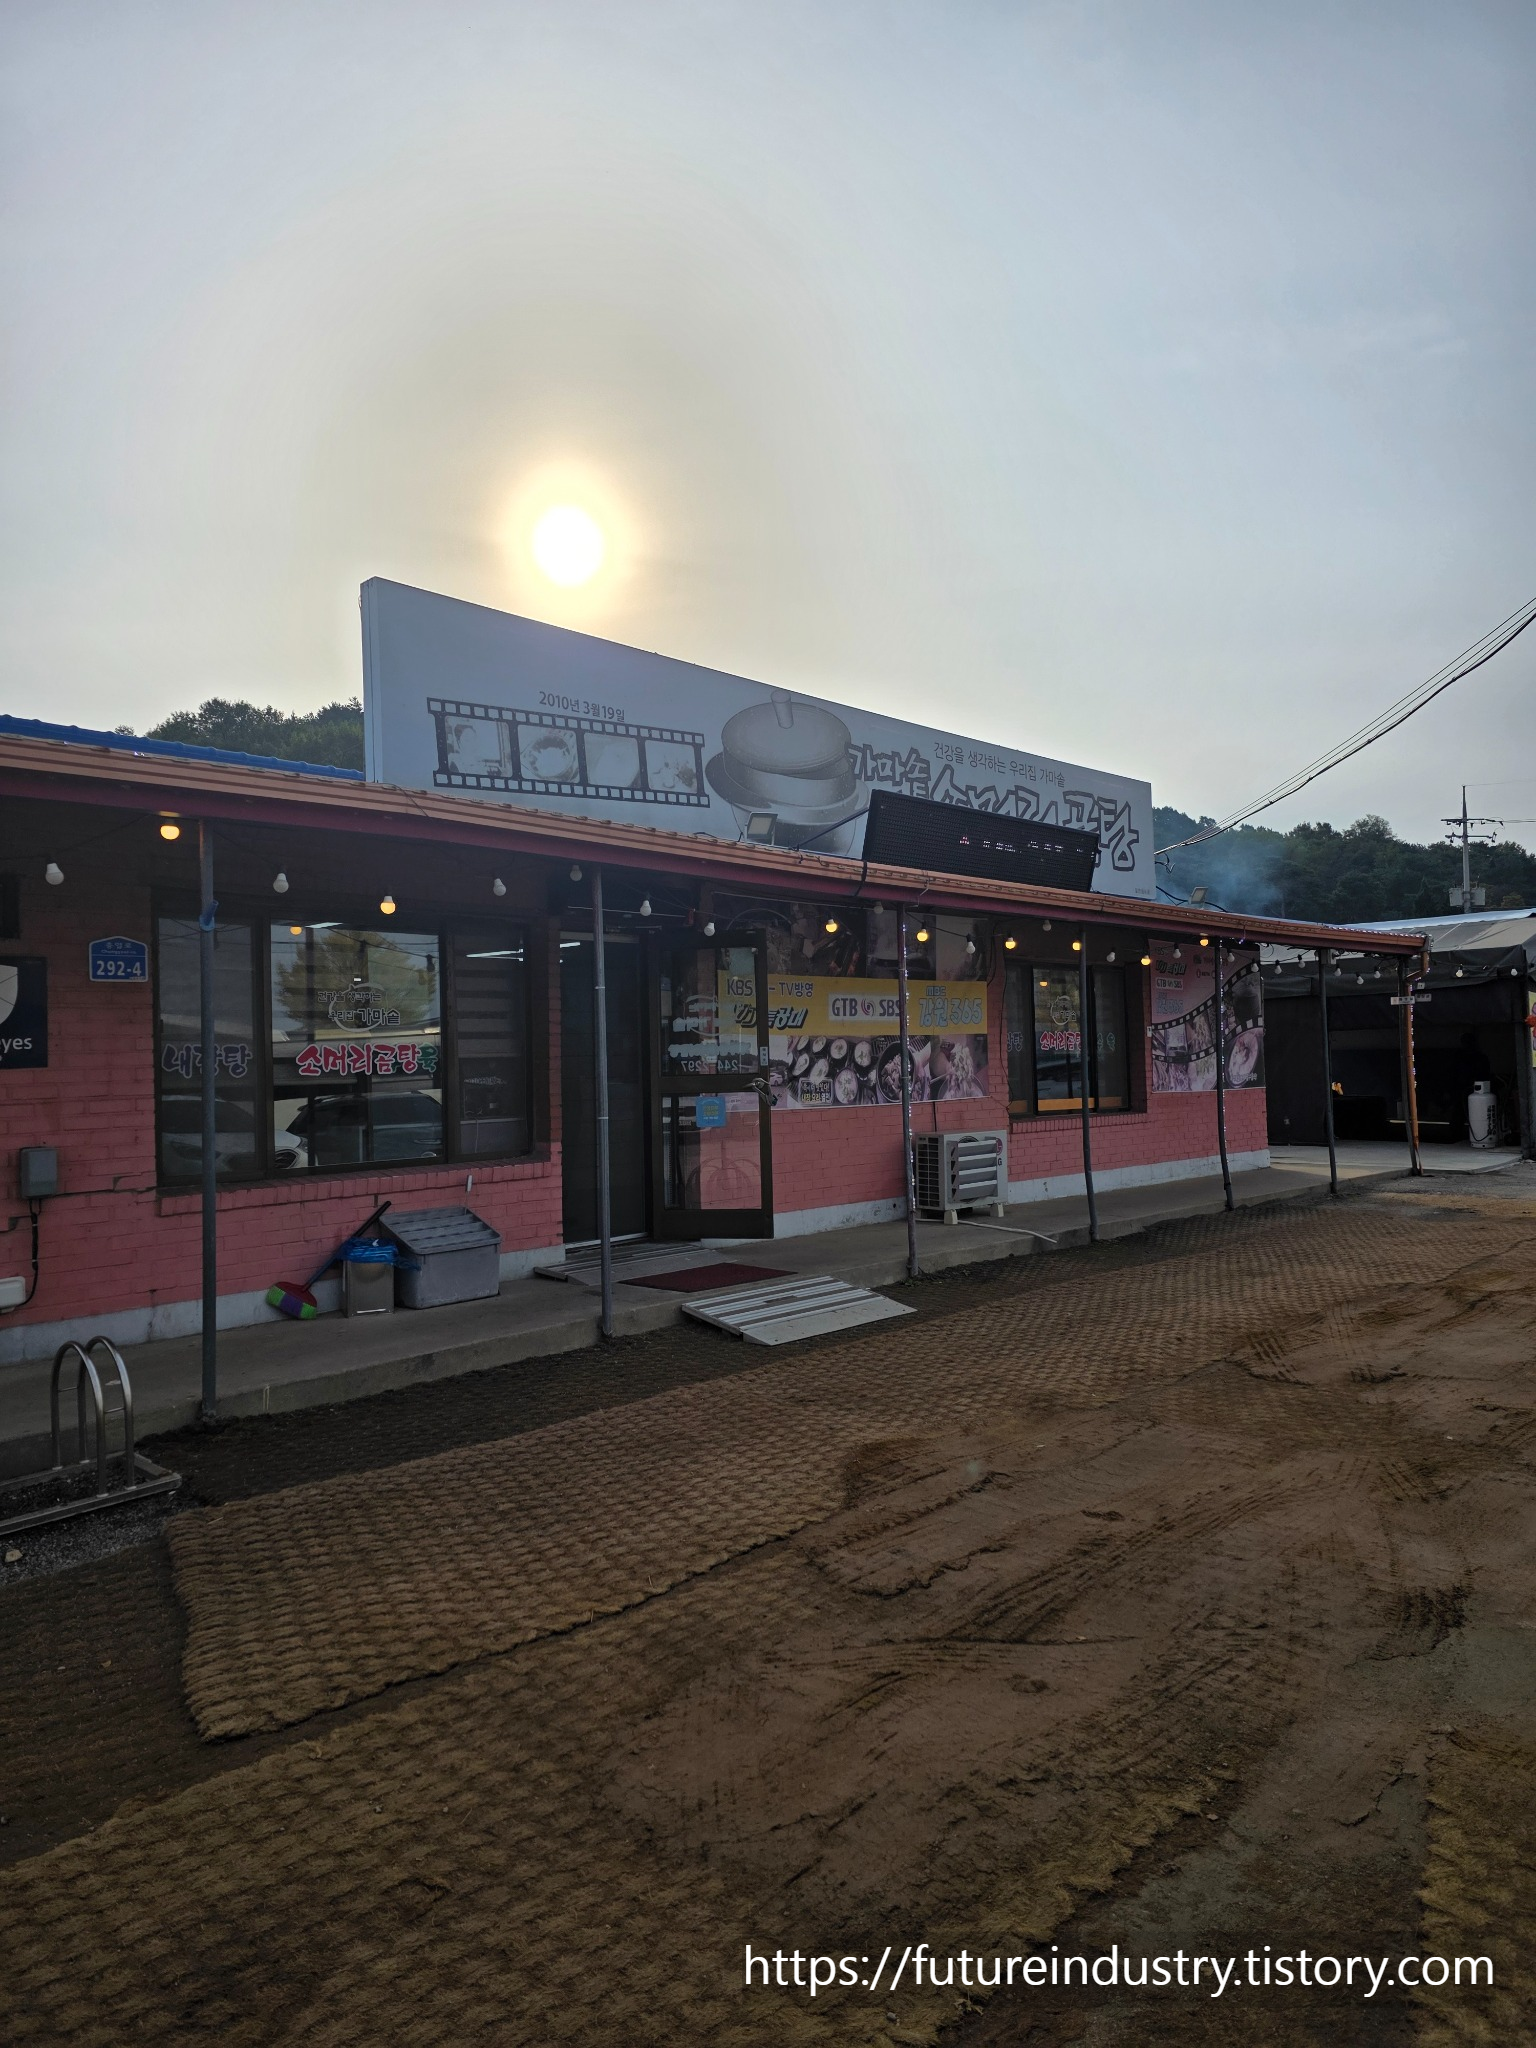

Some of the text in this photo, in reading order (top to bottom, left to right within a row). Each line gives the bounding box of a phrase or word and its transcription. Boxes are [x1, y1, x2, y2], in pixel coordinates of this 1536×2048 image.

[539, 691, 580, 713] 2010년
[934, 742, 964, 765] 건강을
[968, 750, 1006, 775] 생각하는
[1009, 760, 1036, 782] 우리집
[97, 961, 141, 976] 292-4
[727, 979, 814, 998] KBS TV방영
[356, 1008, 400, 1025] 가마솥
[832, 998, 901, 1017] GTB SBS
[0, 1037, 33, 1053] yes
[296, 1043, 422, 1076] 소머리곰탕
